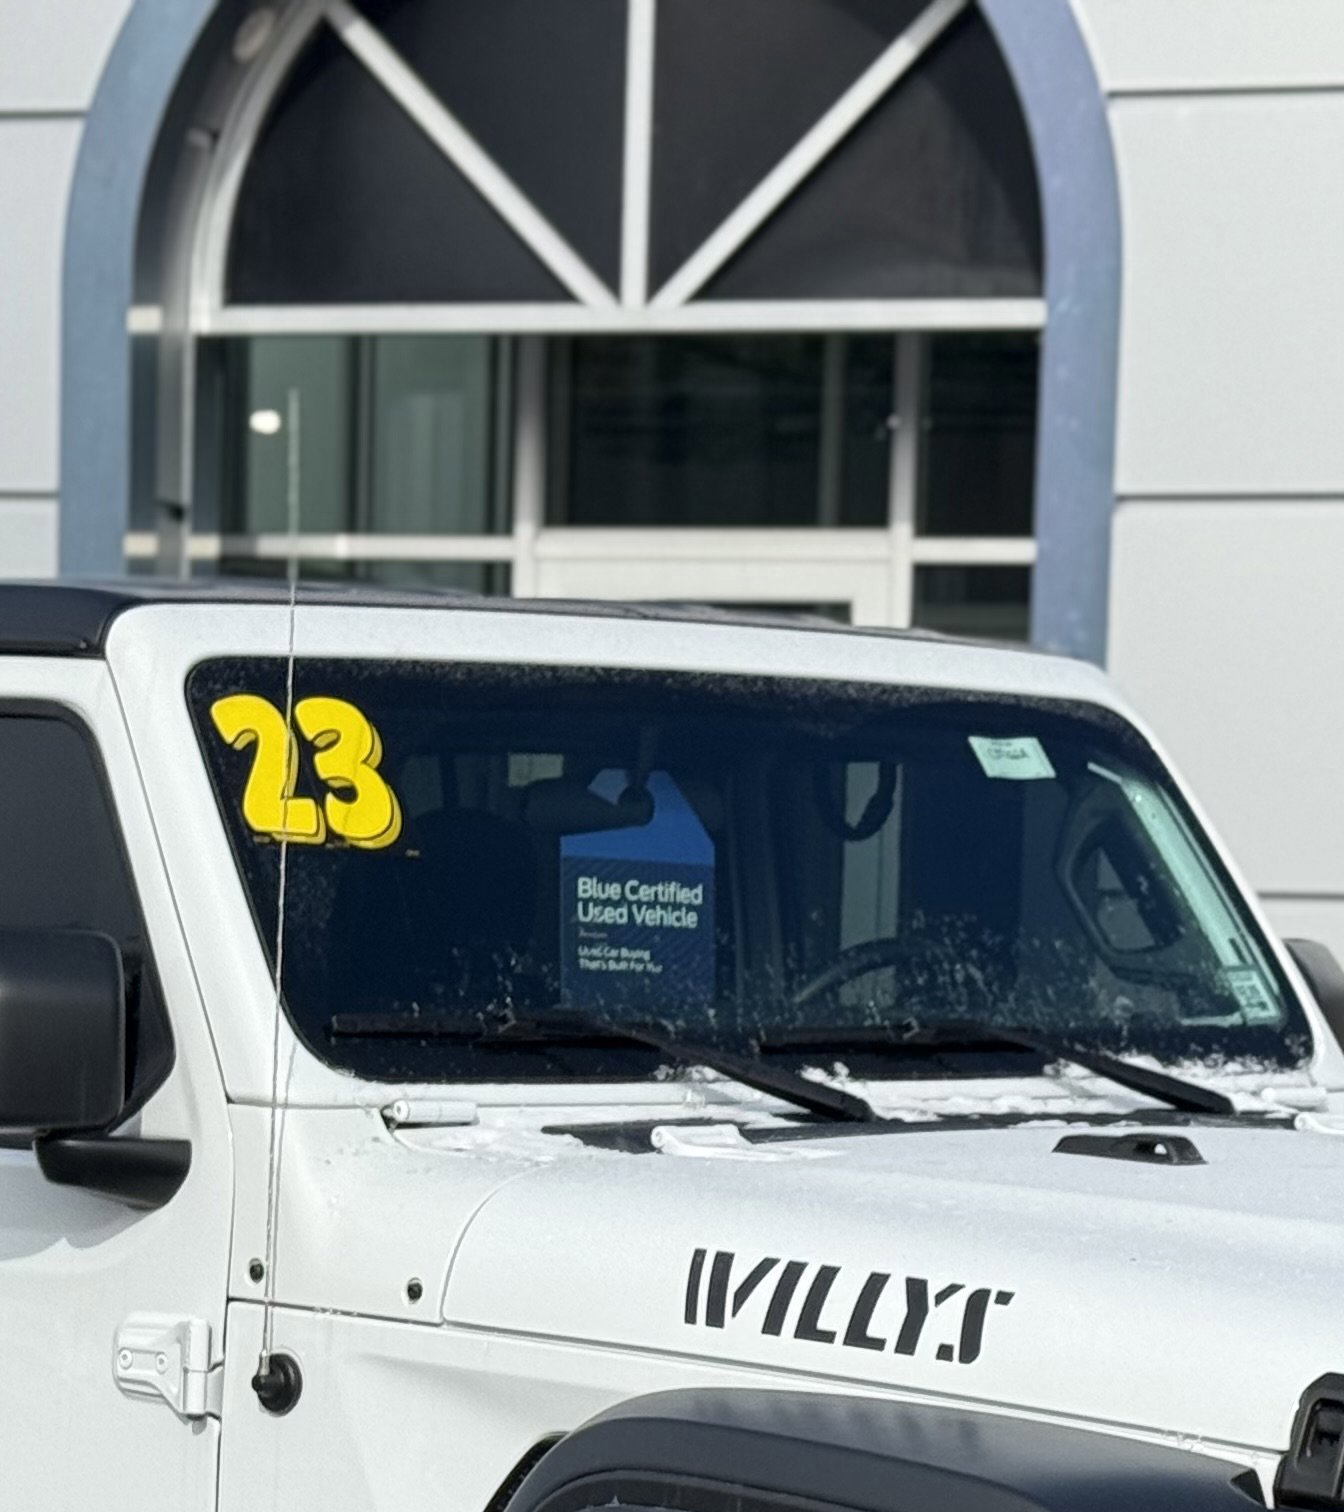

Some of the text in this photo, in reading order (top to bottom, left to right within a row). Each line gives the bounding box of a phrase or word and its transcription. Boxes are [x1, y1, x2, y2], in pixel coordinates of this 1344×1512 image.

[210, 694, 403, 850] 23
[577, 876, 703, 906] Blue Certified
[577, 901, 698, 929] Used Vehicle
[684, 1248, 1016, 1364] WILLYS
